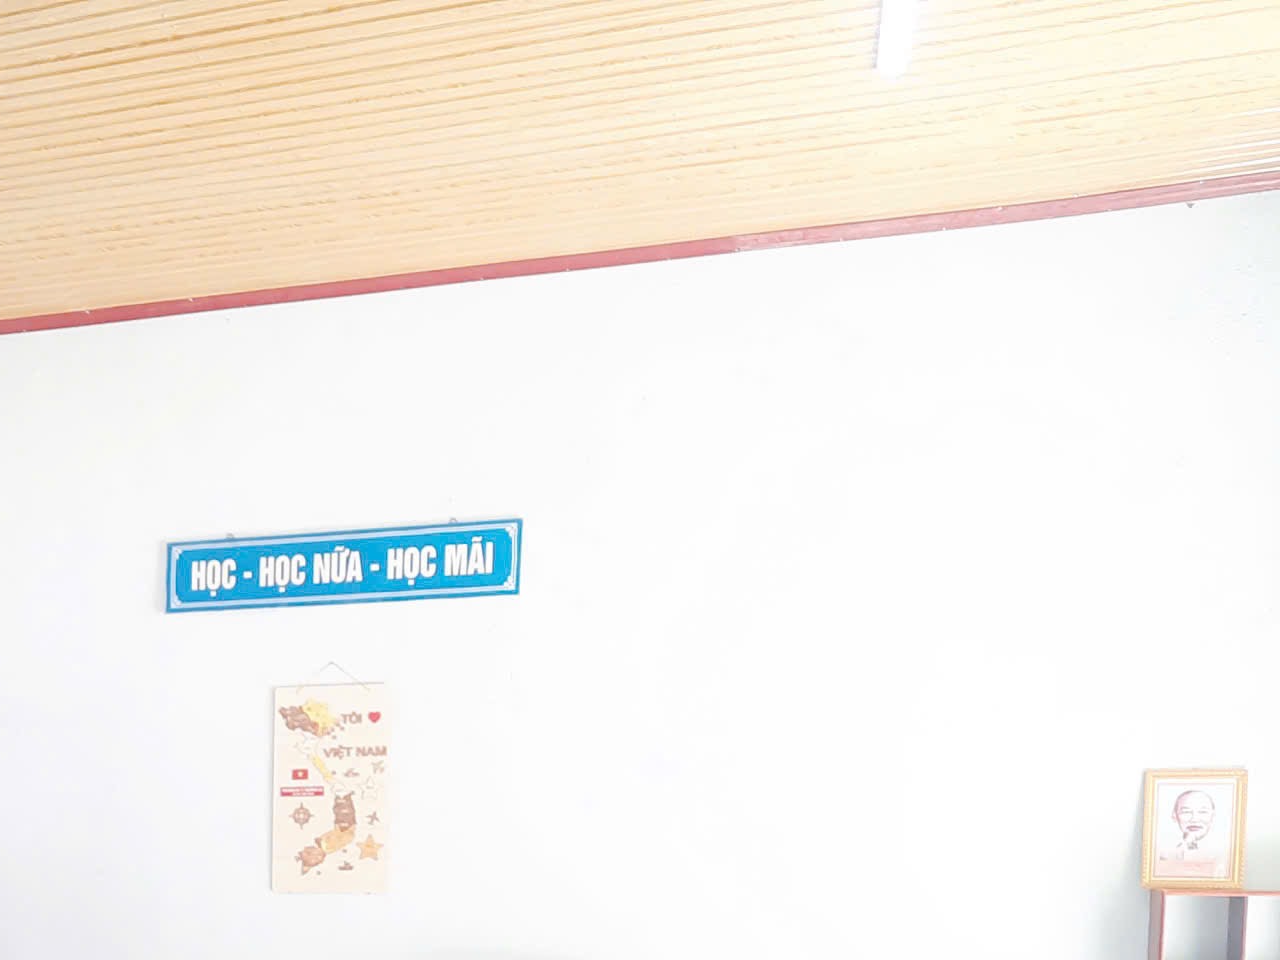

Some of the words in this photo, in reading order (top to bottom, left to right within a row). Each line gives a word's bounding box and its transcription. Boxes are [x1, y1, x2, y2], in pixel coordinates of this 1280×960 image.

[192, 558, 237, 597] HỌC
[243, 571, 253, 579] -
[259, 554, 306, 593] HỌC
[313, 545, 363, 584] NỮA
[370, 563, 380, 572] -
[387, 545, 437, 586] HỌC
[444, 536, 494, 576] MÃI
[340, 711, 363, 724] TÔI
[323, 745, 352, 760] VIỆT
[355, 745, 387, 757] NAM
